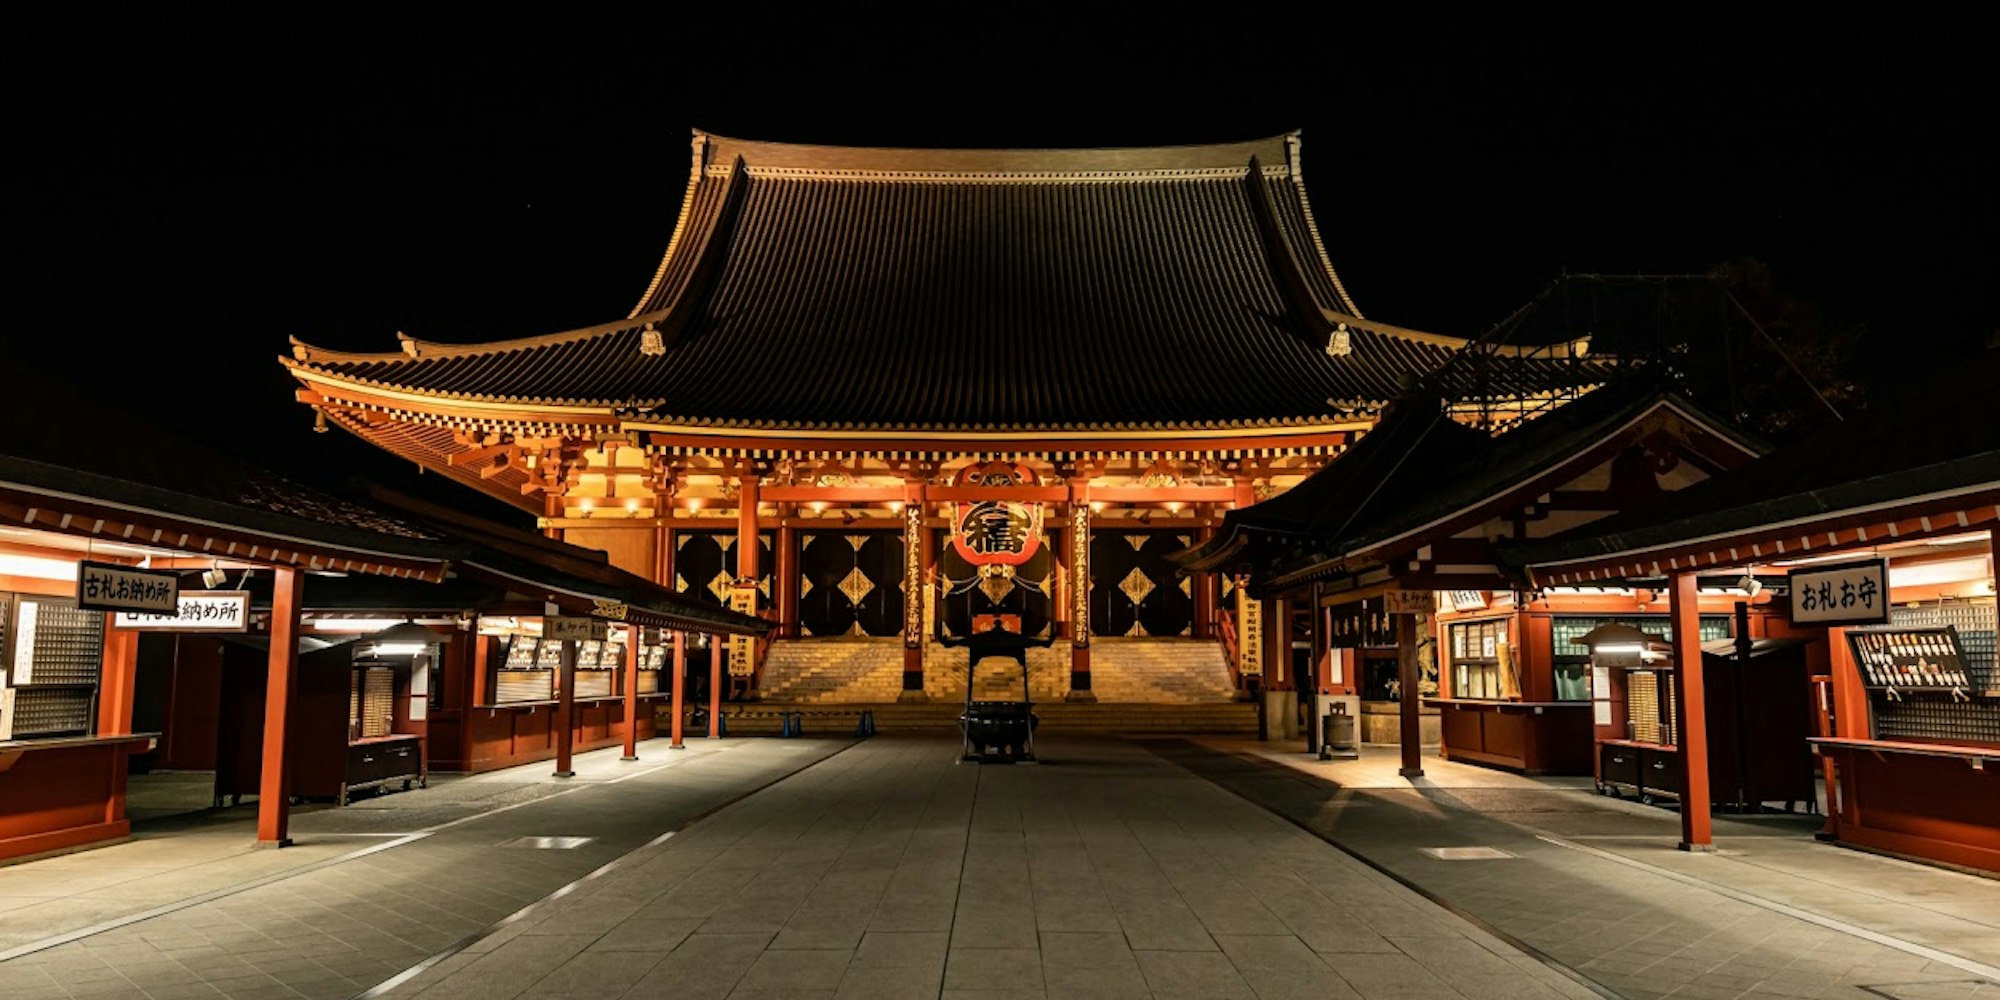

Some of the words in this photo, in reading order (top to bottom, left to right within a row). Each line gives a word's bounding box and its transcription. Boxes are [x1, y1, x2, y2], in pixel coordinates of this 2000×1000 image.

[85, 573, 171, 605] 古札お納め所
[1801, 575, 1878, 612] お札お守
